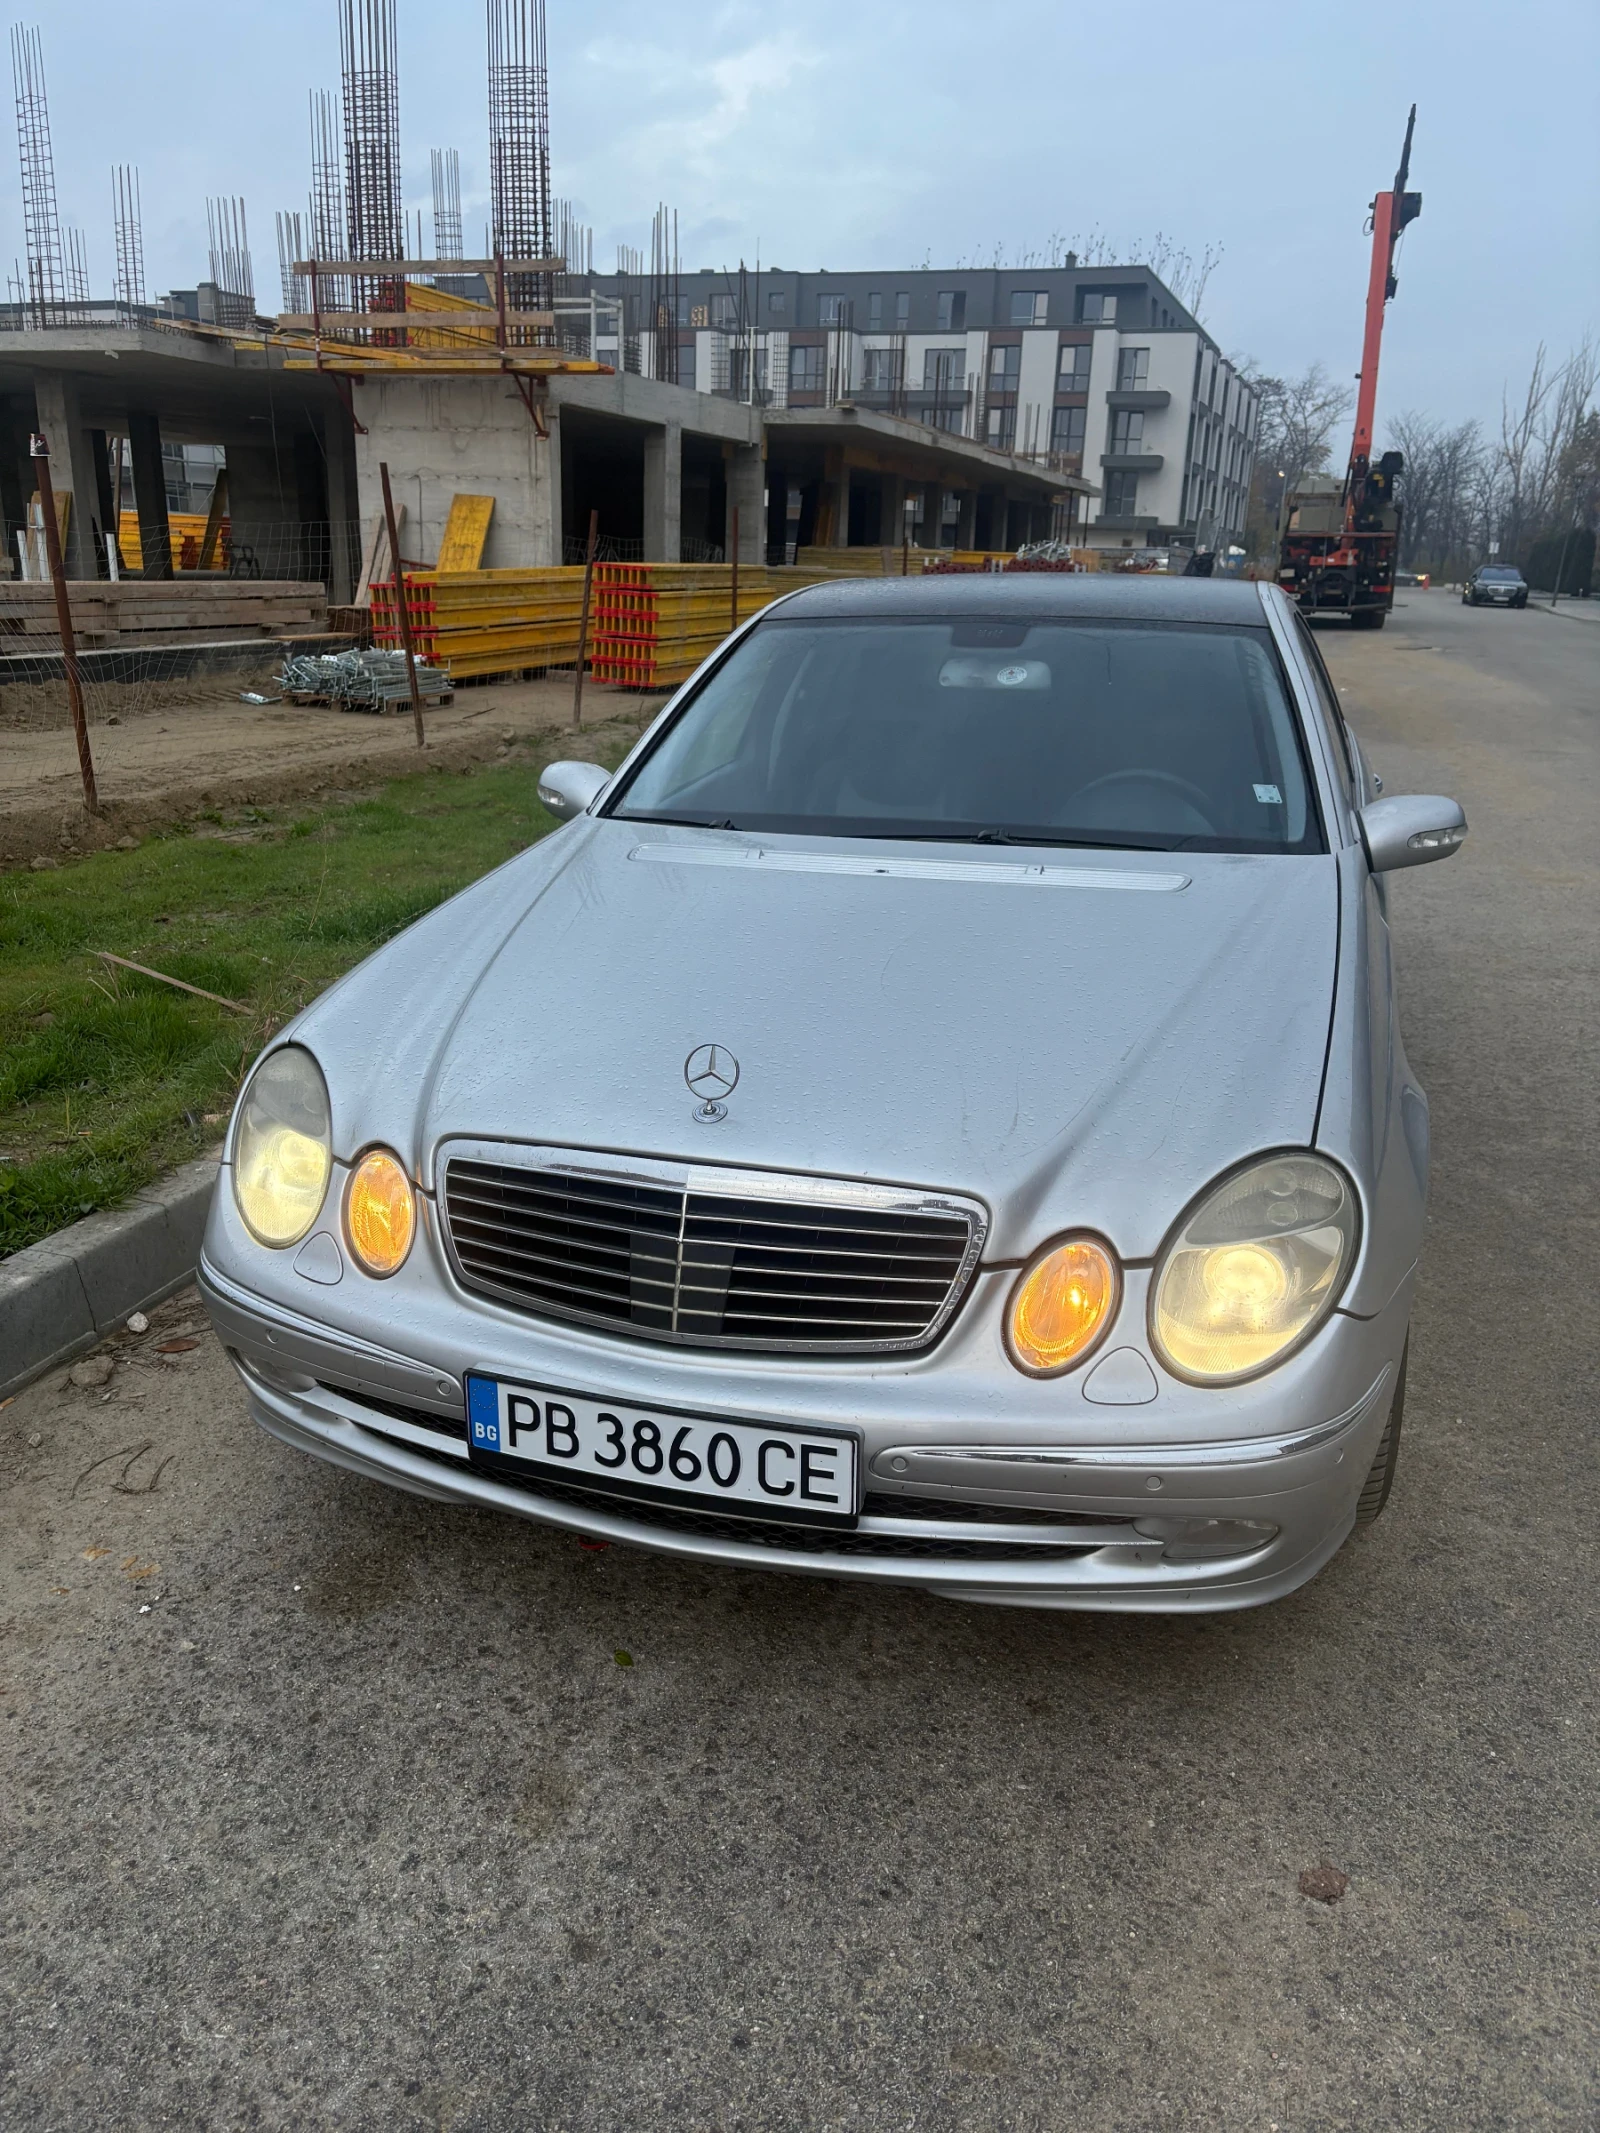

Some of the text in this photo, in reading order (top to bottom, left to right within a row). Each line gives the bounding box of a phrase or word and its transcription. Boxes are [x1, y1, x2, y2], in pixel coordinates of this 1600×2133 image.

[474, 1421, 497, 1442] BG
[506, 1393, 839, 1503] PB 3860 CE
